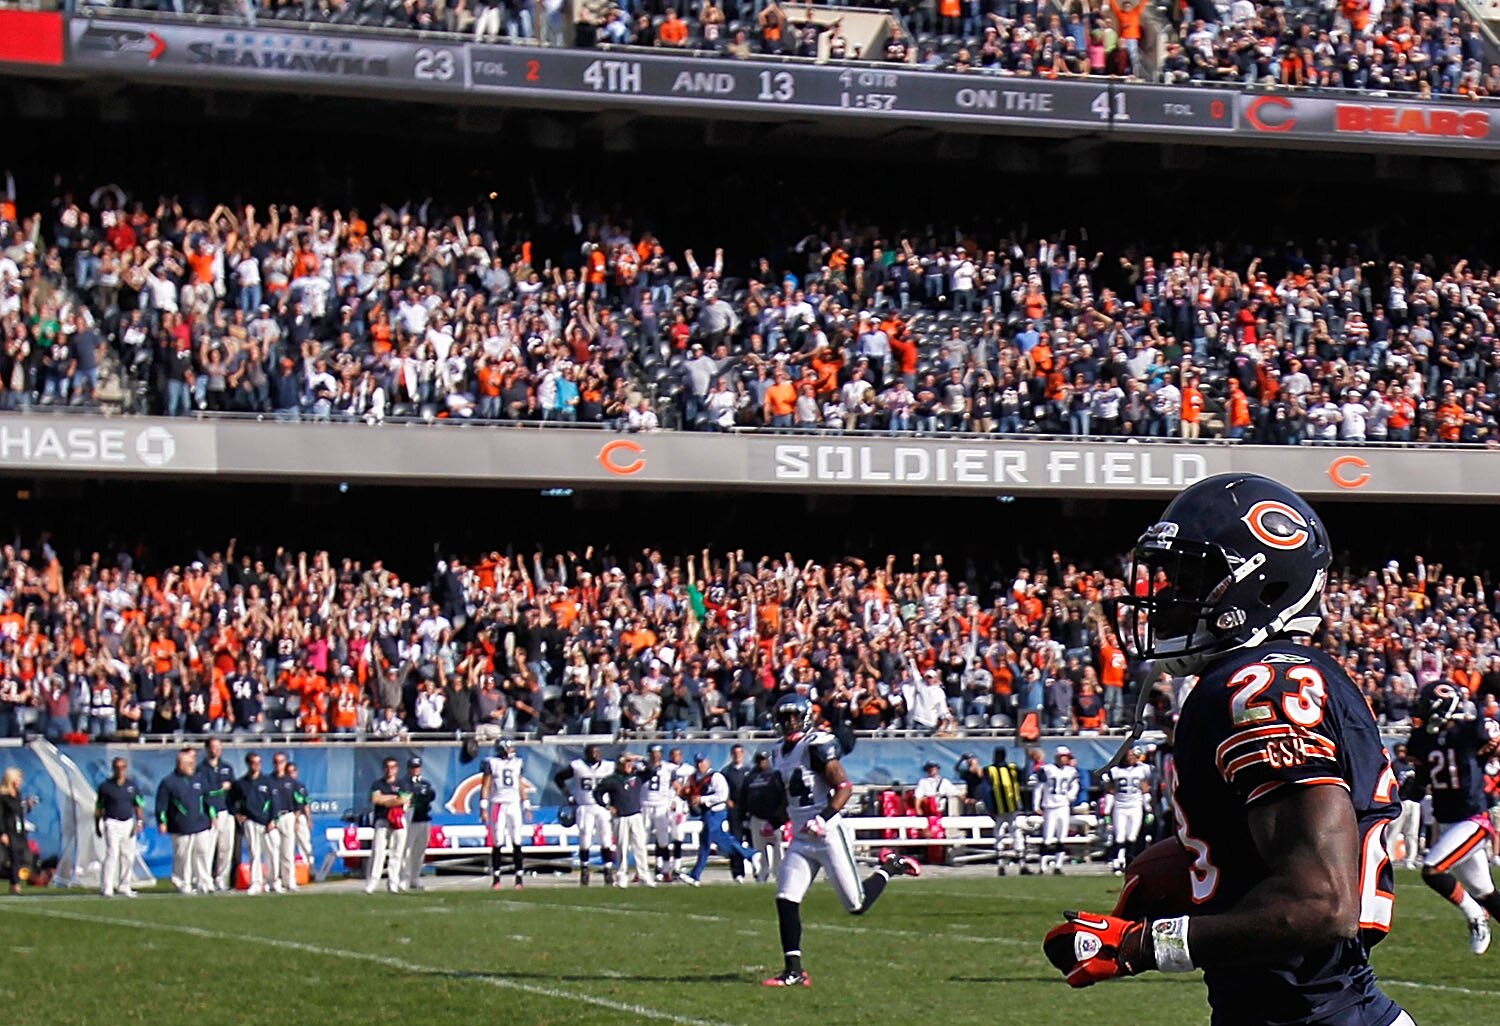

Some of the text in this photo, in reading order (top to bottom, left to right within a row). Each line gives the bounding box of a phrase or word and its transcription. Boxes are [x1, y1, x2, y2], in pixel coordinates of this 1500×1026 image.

[414, 48, 455, 80] 23
[525, 60, 540, 80] 2
[839, 69, 851, 87] 4
[583, 60, 795, 101] 4TH AND 13
[840, 92, 898, 110] 1:57
[956, 88, 1131, 121] ON THE 41
[1335, 103, 1490, 139] BEARS
[775, 444, 1207, 485] SOLDIER FIELD
[233, 680, 252, 699] 54
[1227, 662, 1328, 728] 23
[1266, 736, 1306, 768] GSH
[502, 768, 514, 787] 6
[1427, 749, 1460, 790] 21
